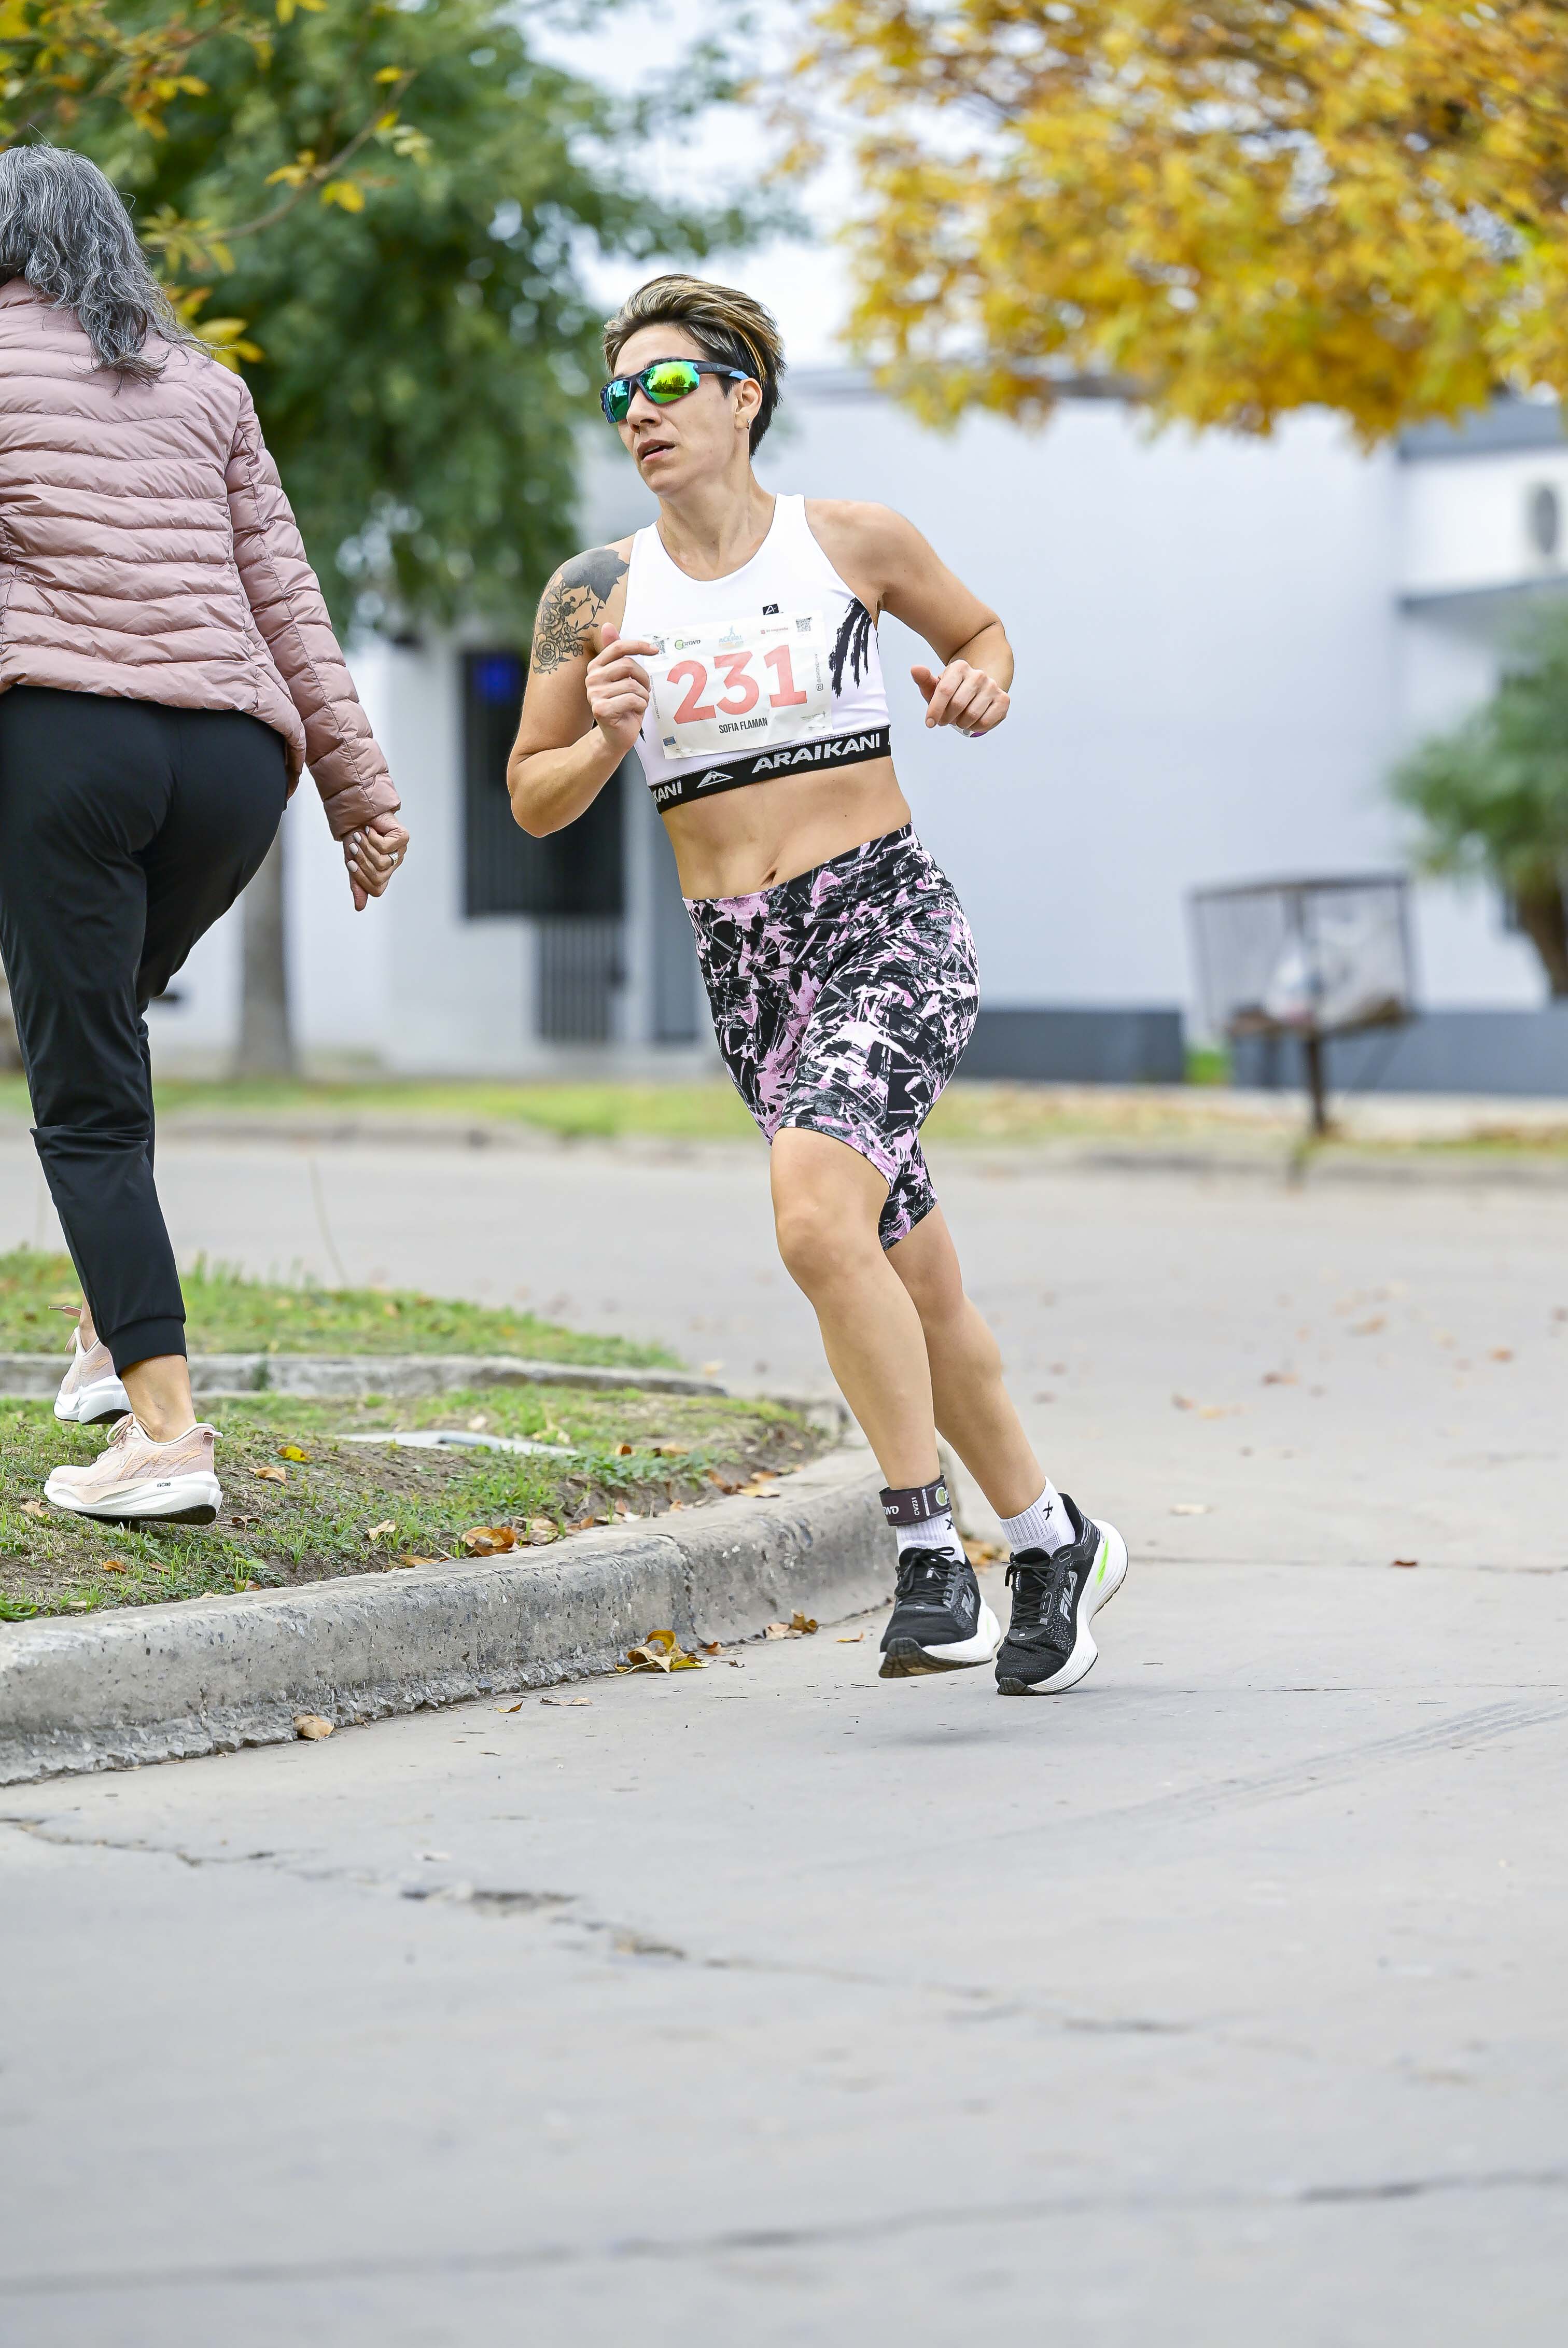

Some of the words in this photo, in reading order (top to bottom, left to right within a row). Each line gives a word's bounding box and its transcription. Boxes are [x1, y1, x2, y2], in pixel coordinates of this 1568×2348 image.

[667, 645, 807, 724] 231
[719, 723, 739, 733] SOFIA
[740, 718, 767, 730] FLAMAN
[751, 733, 880, 774] ARAIKANI
[1059, 1571, 1078, 1623] FILA
